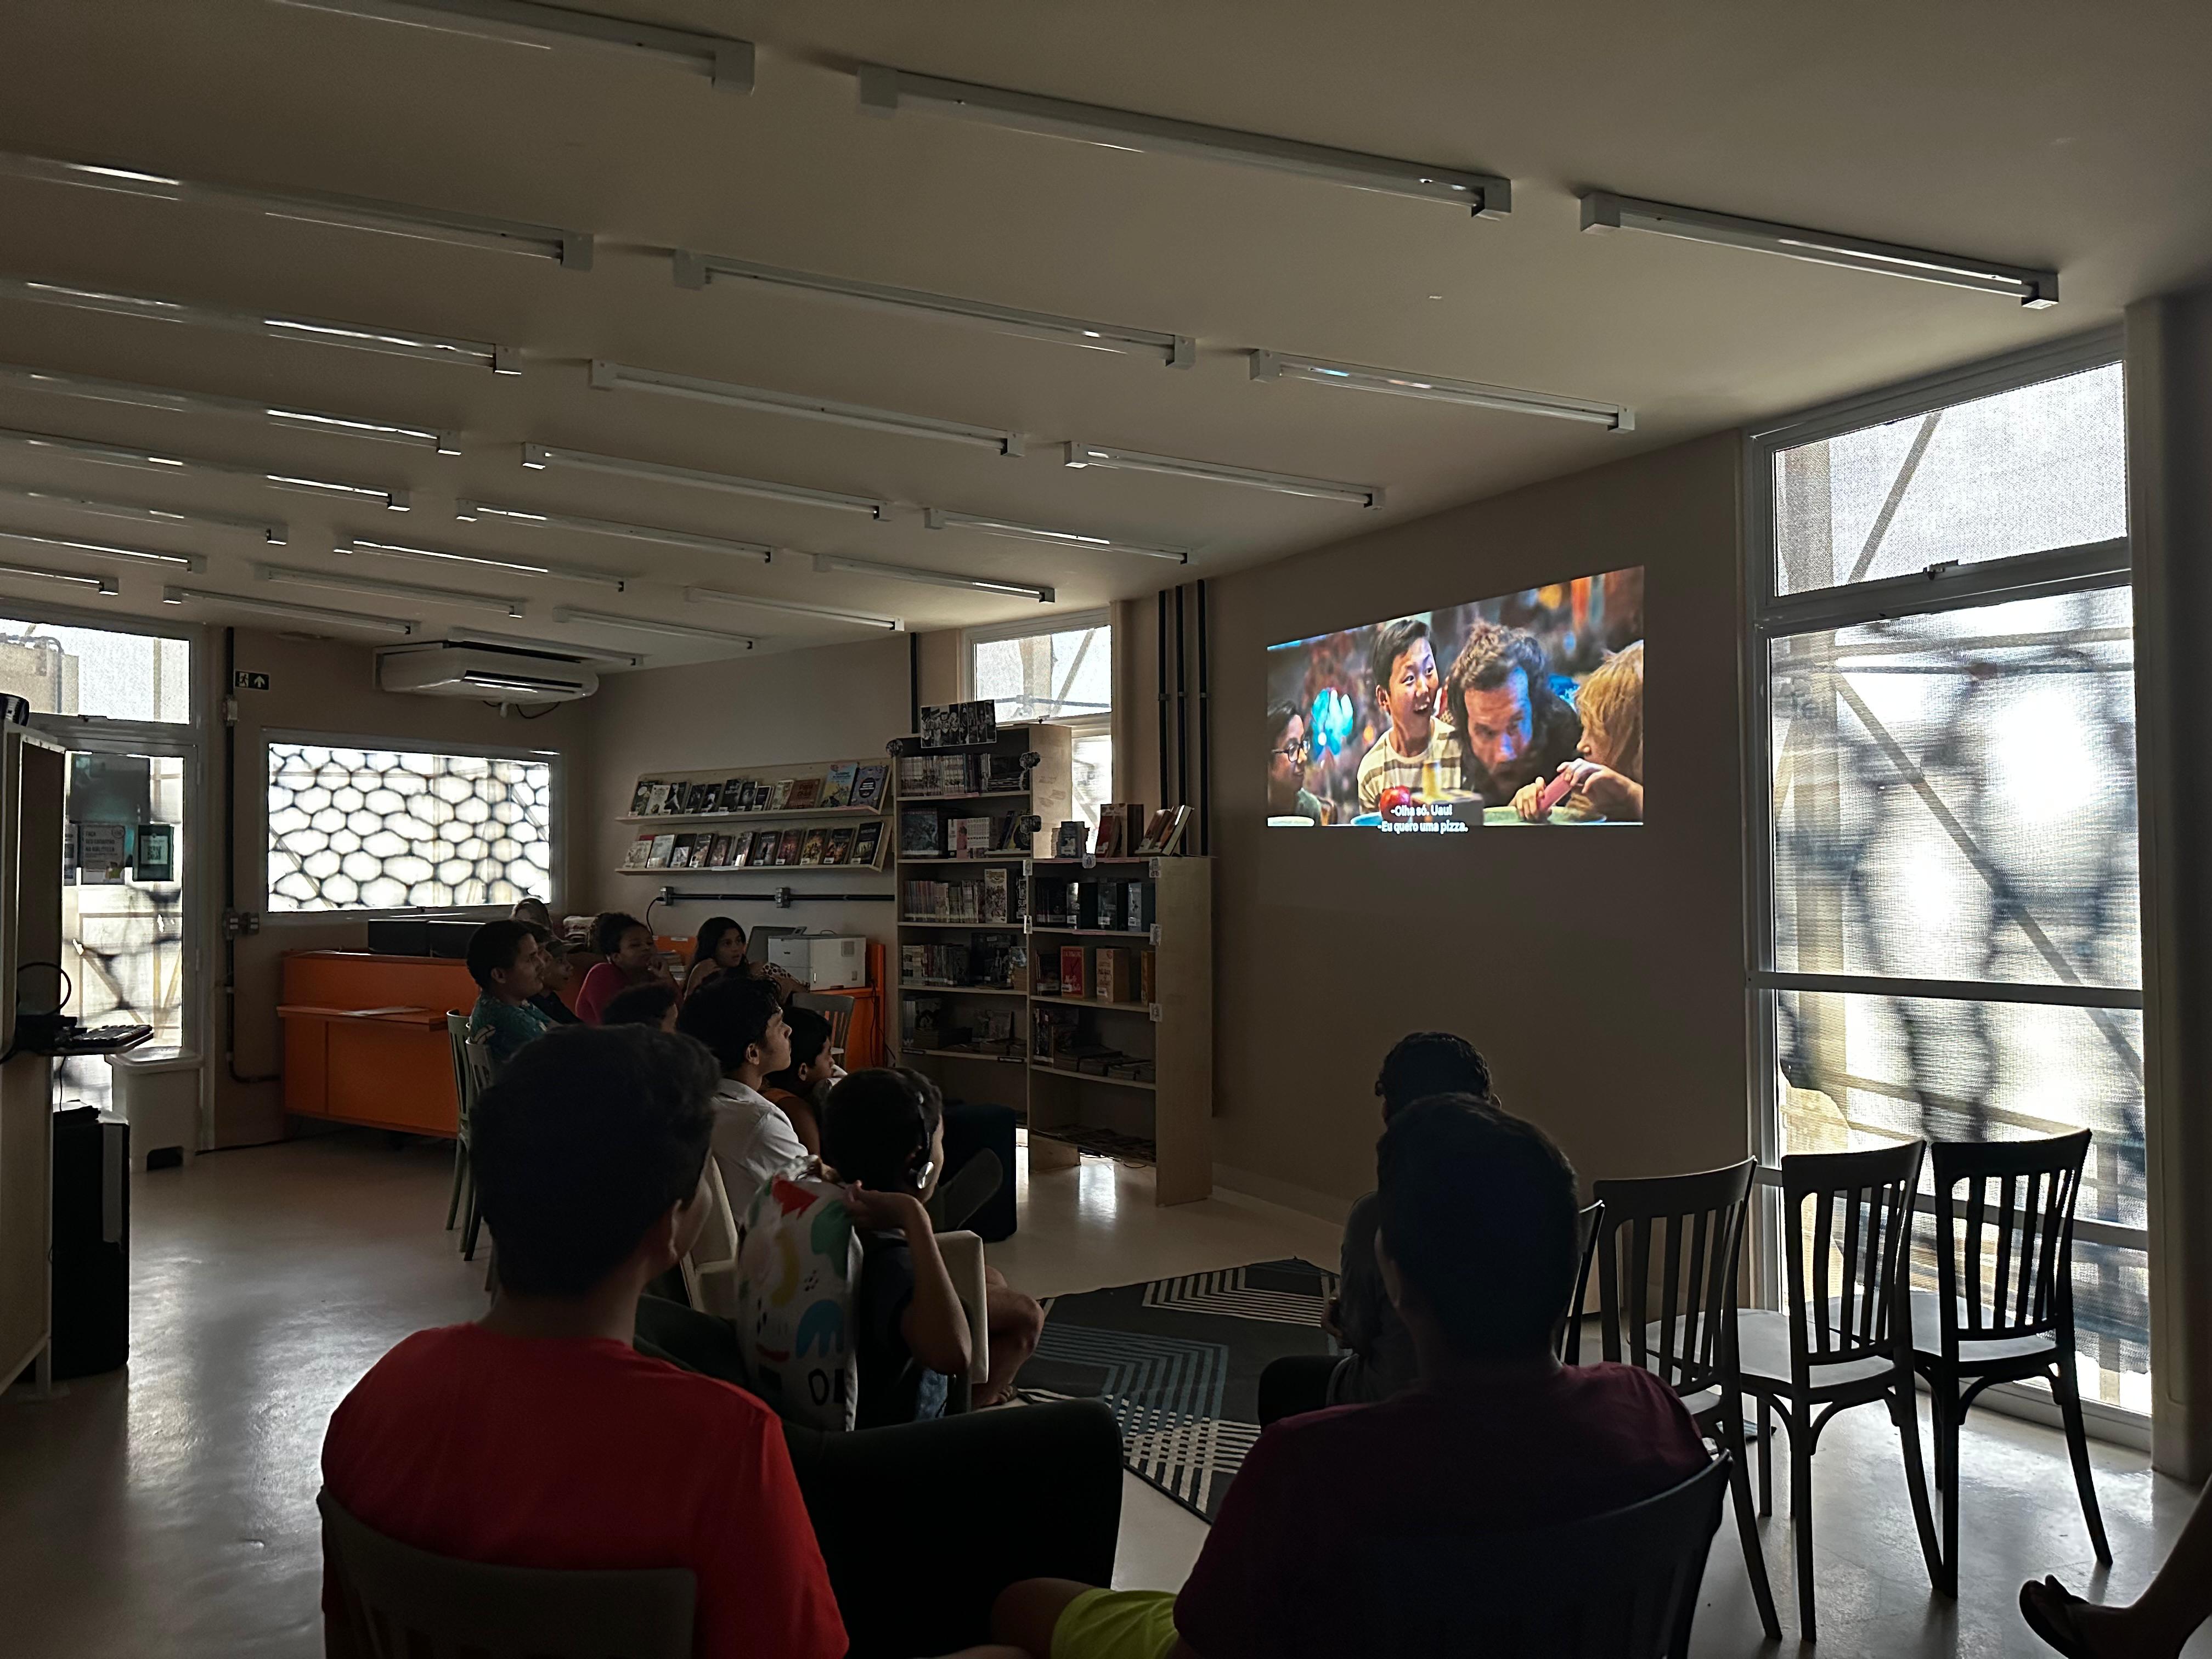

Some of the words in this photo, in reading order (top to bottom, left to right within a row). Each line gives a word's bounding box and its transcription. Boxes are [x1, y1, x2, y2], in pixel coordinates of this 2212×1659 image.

[1390, 805, 1415, 816] -Olha
[1416, 804, 1430, 816] só.
[1430, 804, 1453, 816] Uau!
[1378, 821, 1393, 832] -Eu
[1393, 822, 1419, 834] quero
[1419, 822, 1440, 832] uma
[1440, 819, 1469, 834] pizza.
